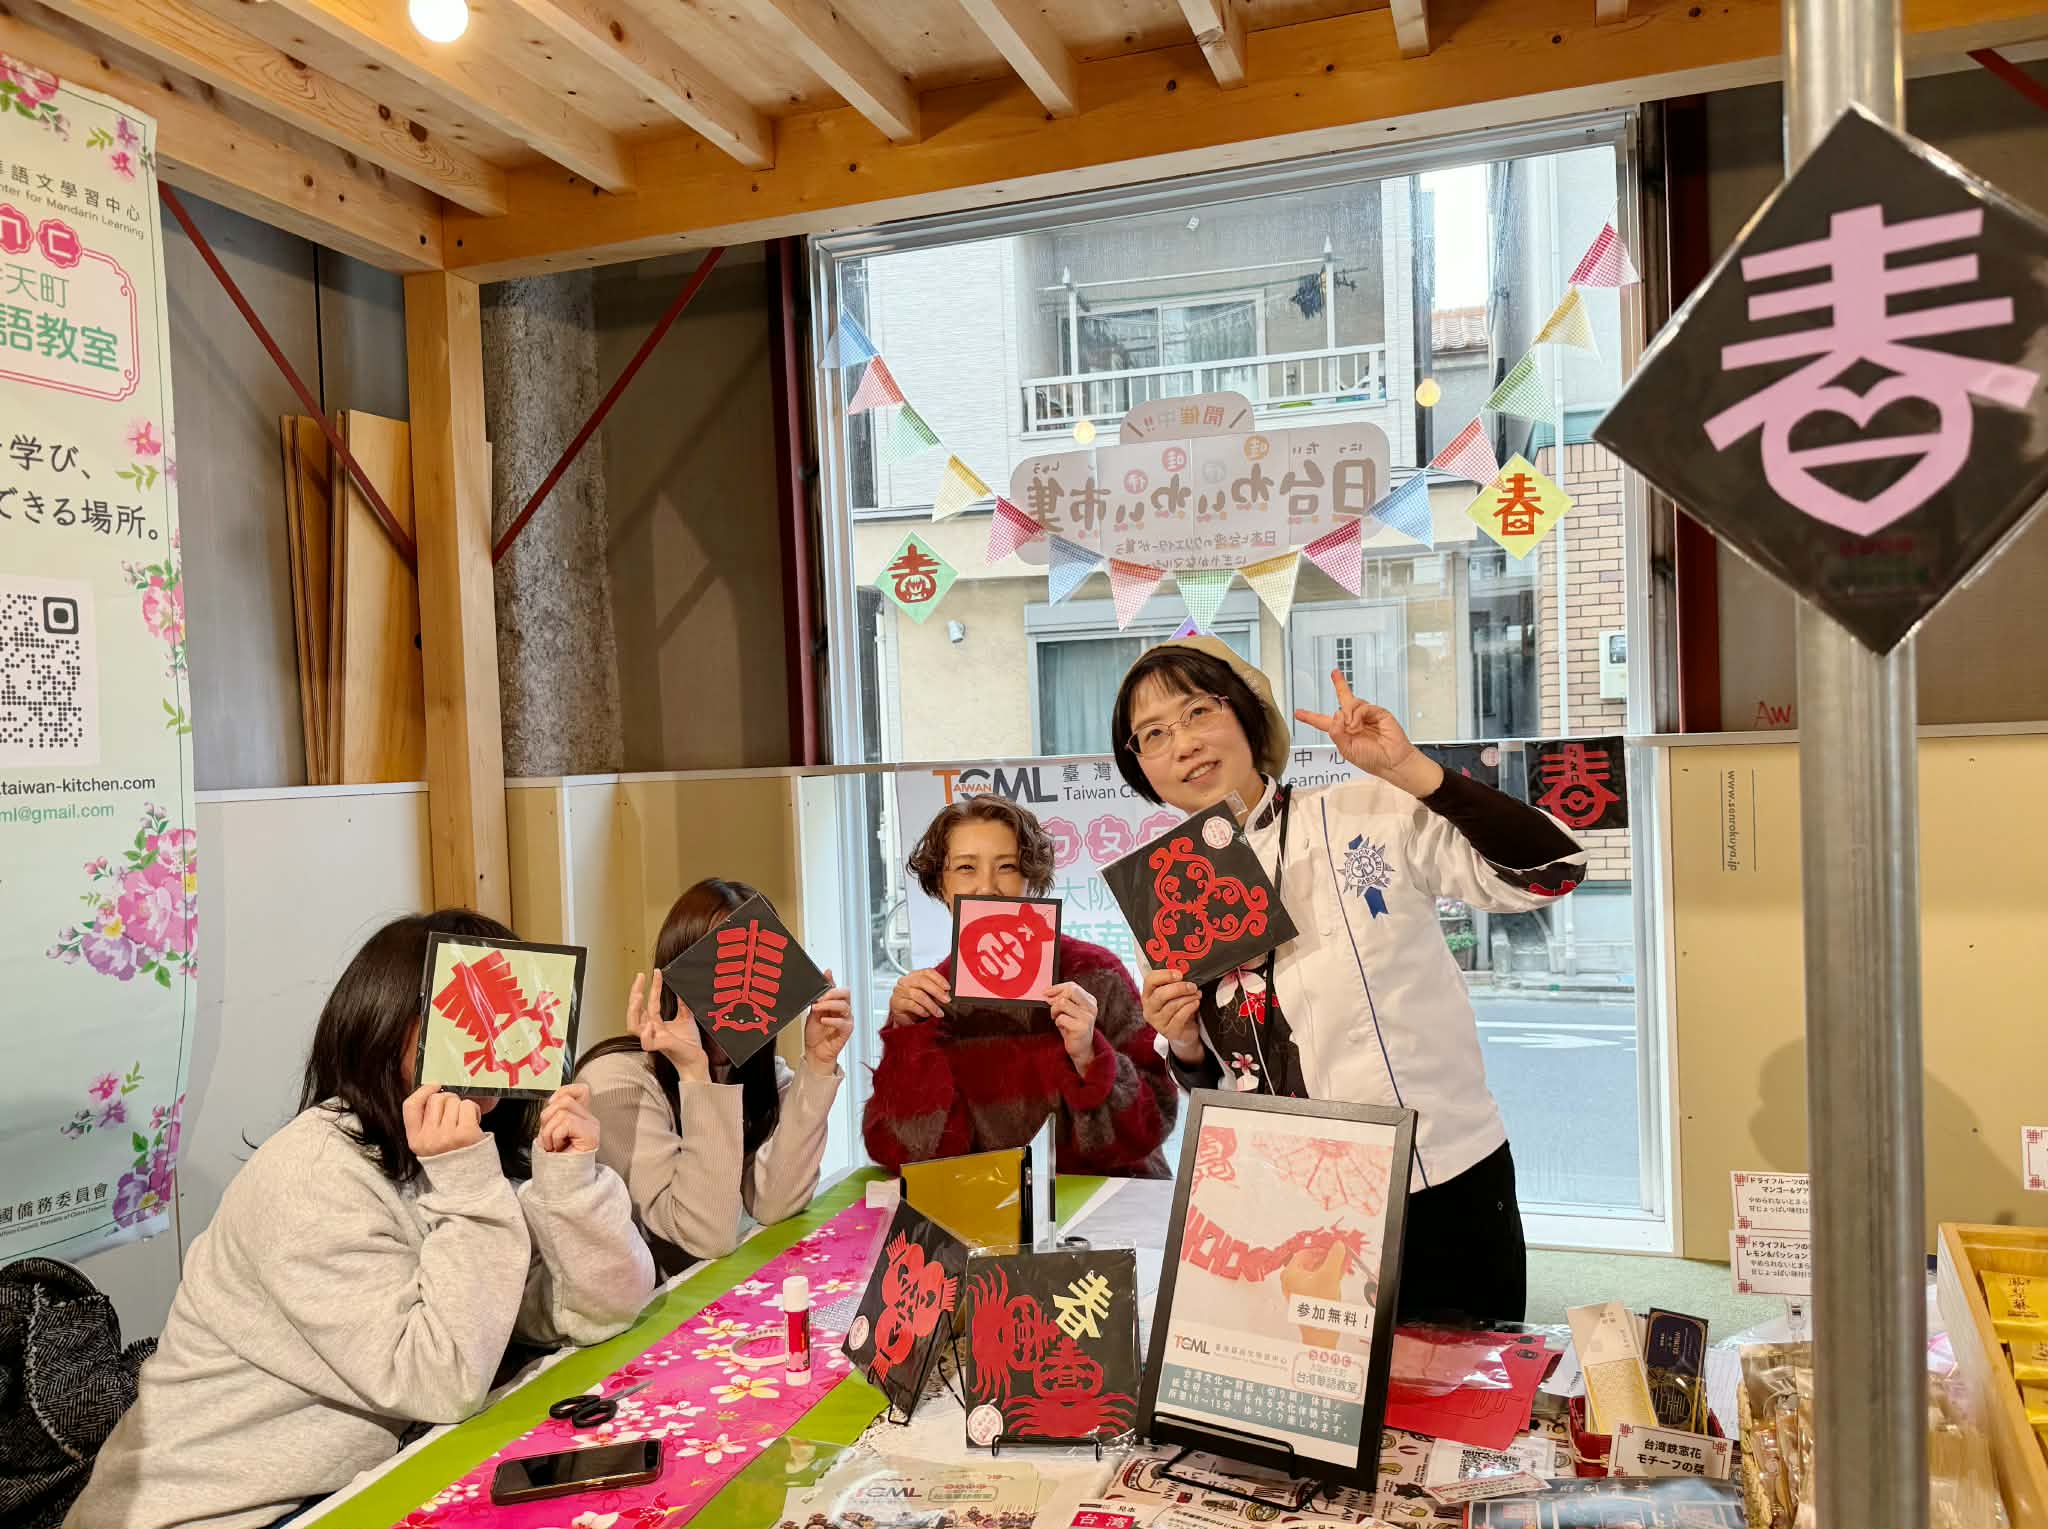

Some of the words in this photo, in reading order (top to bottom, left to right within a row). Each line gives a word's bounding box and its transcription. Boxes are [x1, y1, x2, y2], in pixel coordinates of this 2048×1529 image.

[0, 262, 70, 309] 天町
[1704, 203, 2040, 536] 春
[0, 434, 91, 480] 学び、
[1493, 473, 1544, 537] 春
[1064, 785, 1117, 801] Taiwan
